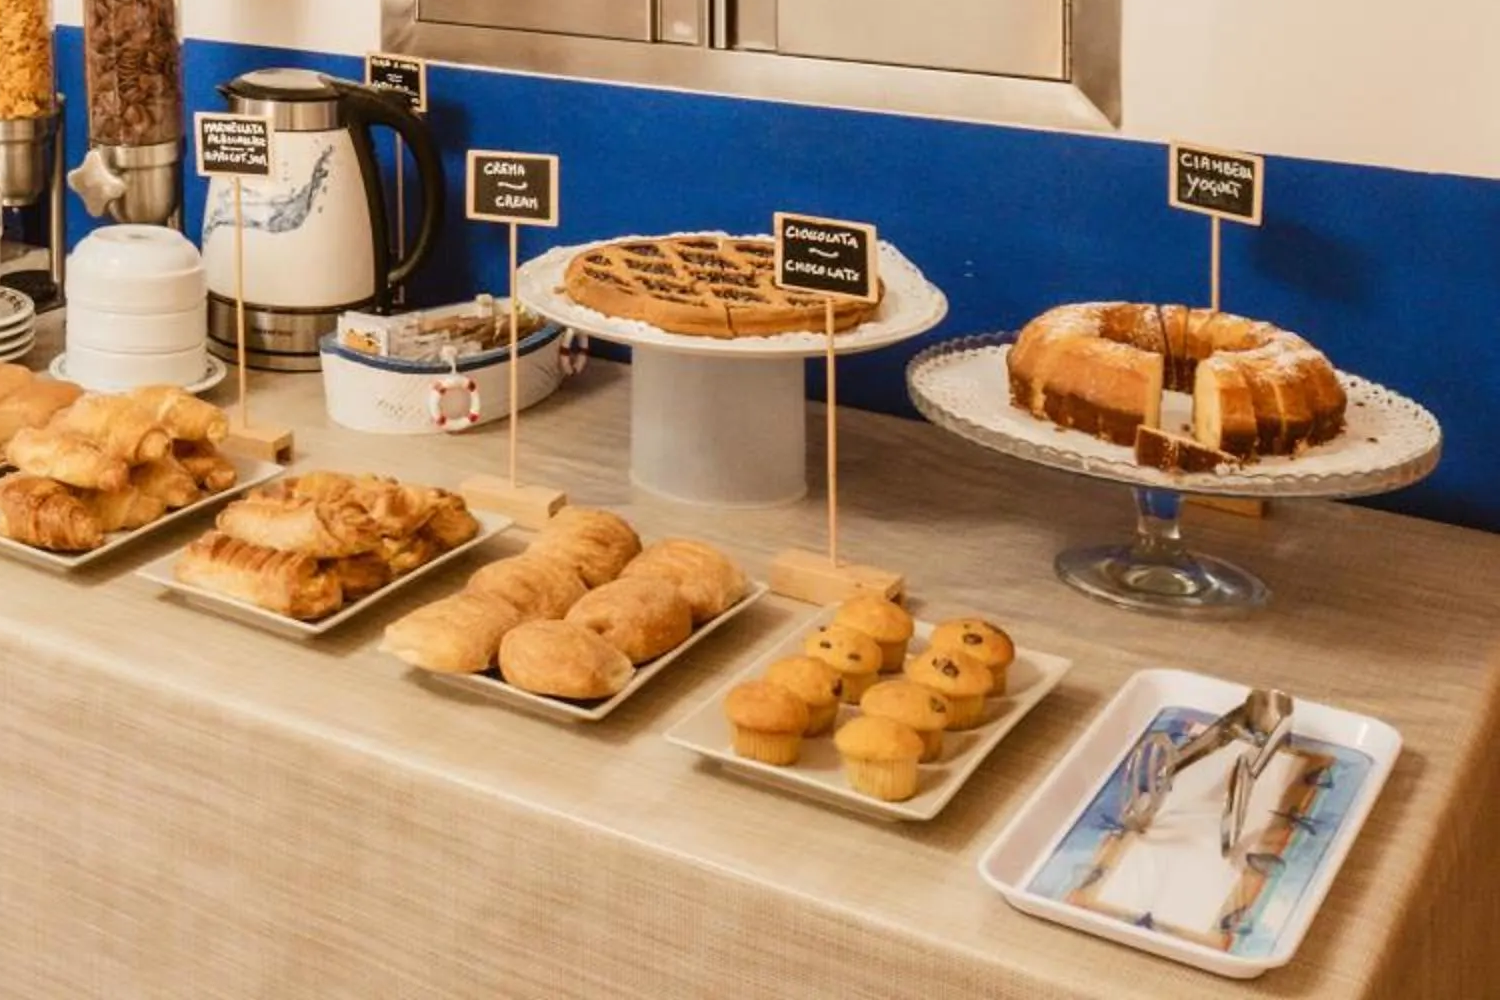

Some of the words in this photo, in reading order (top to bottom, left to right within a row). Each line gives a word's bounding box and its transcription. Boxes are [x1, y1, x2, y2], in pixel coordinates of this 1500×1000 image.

[483, 161, 526, 177] CREMA
[495, 194, 539, 211] CREAM
[784, 259, 860, 282] CHOCOLATE
